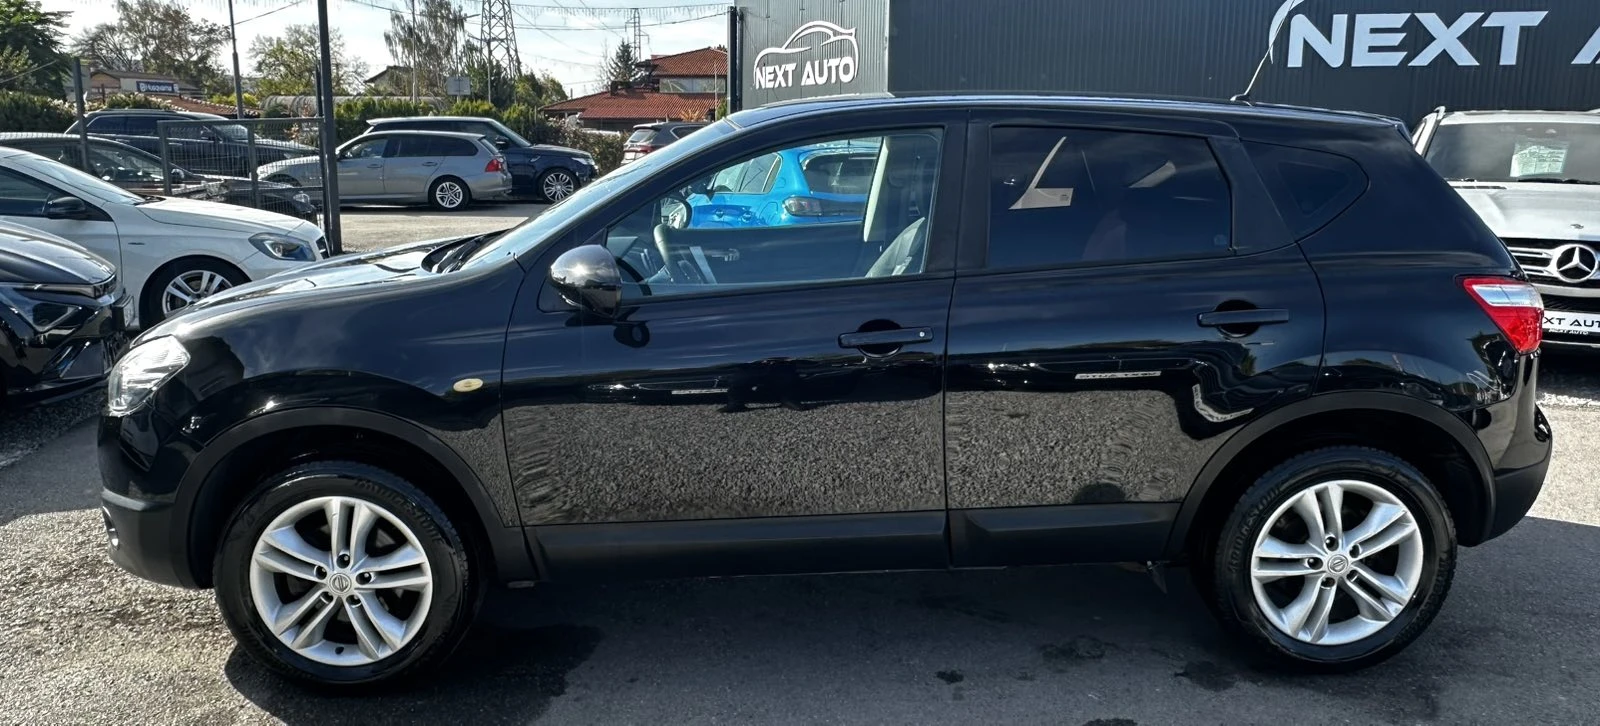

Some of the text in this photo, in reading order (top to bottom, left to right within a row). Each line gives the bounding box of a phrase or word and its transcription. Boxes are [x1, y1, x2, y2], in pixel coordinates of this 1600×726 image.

[1287, 11, 1549, 68] NEXT
[756, 56, 855, 90] NEXT AUTO
[1543, 316, 1600, 328] XT AUT
